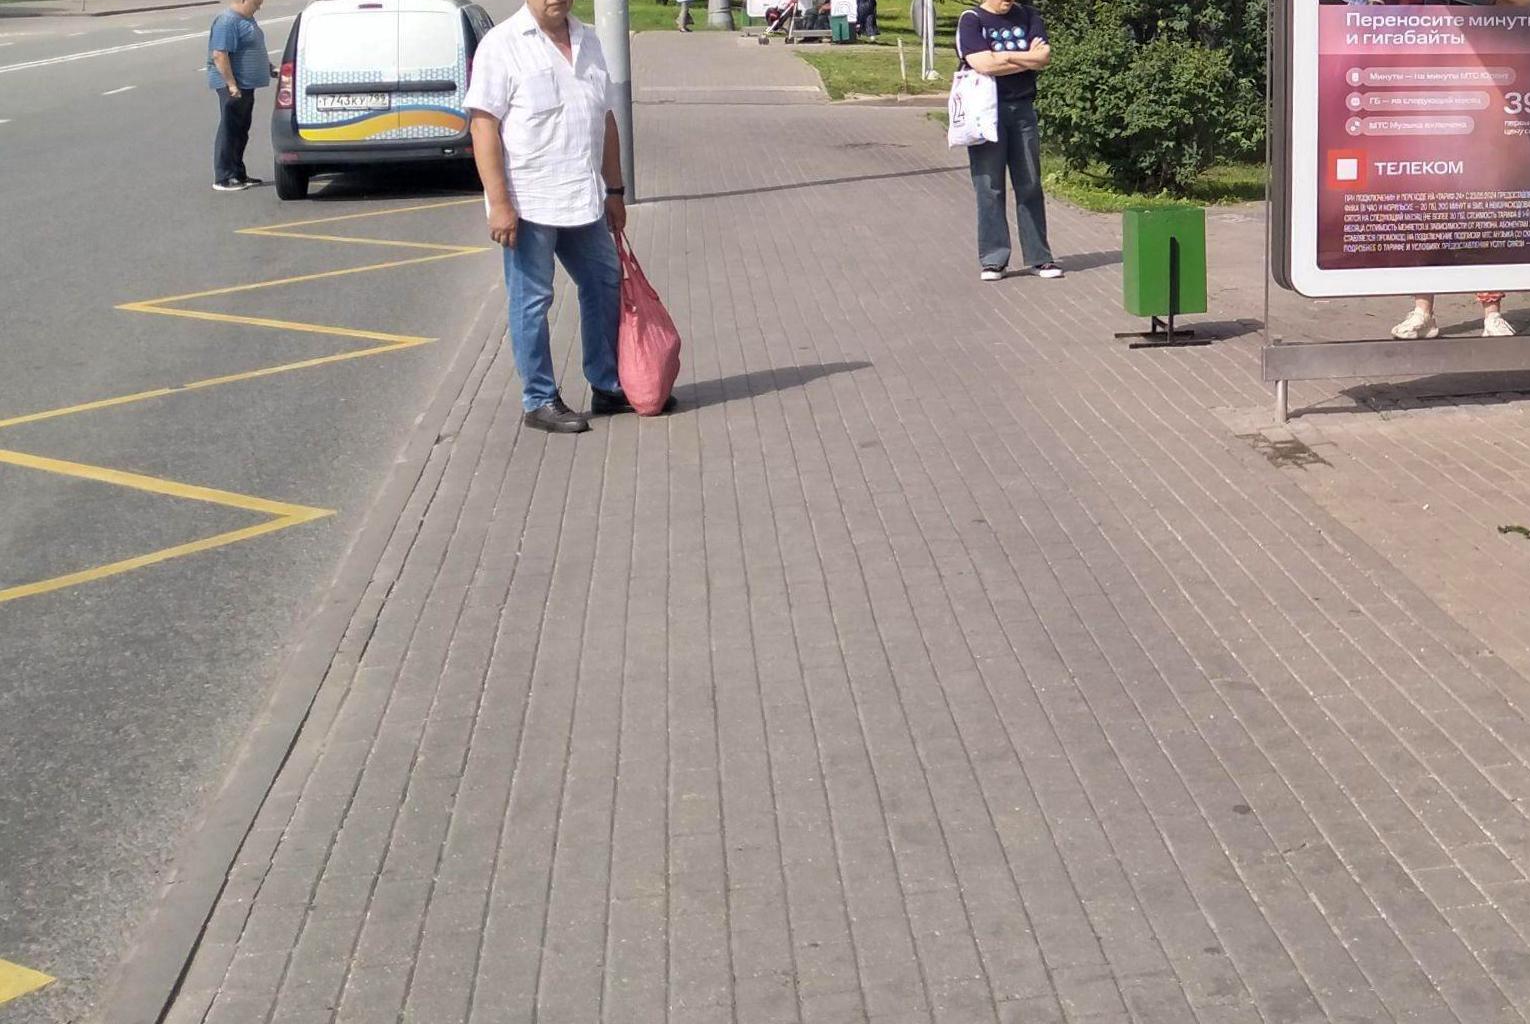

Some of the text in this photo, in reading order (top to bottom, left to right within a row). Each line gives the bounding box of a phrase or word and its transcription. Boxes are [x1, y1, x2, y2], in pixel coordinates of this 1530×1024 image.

[1345, 12, 1465, 30] Переносите
[1346, 29, 1465, 45] и гигабайты
[1369, 71, 1404, 82] Минуты
[1427, 71, 1459, 82] минуты
[1369, 96, 1381, 106] ГБ
[1374, 160, 1464, 176] ТЕЛЕКОМ
